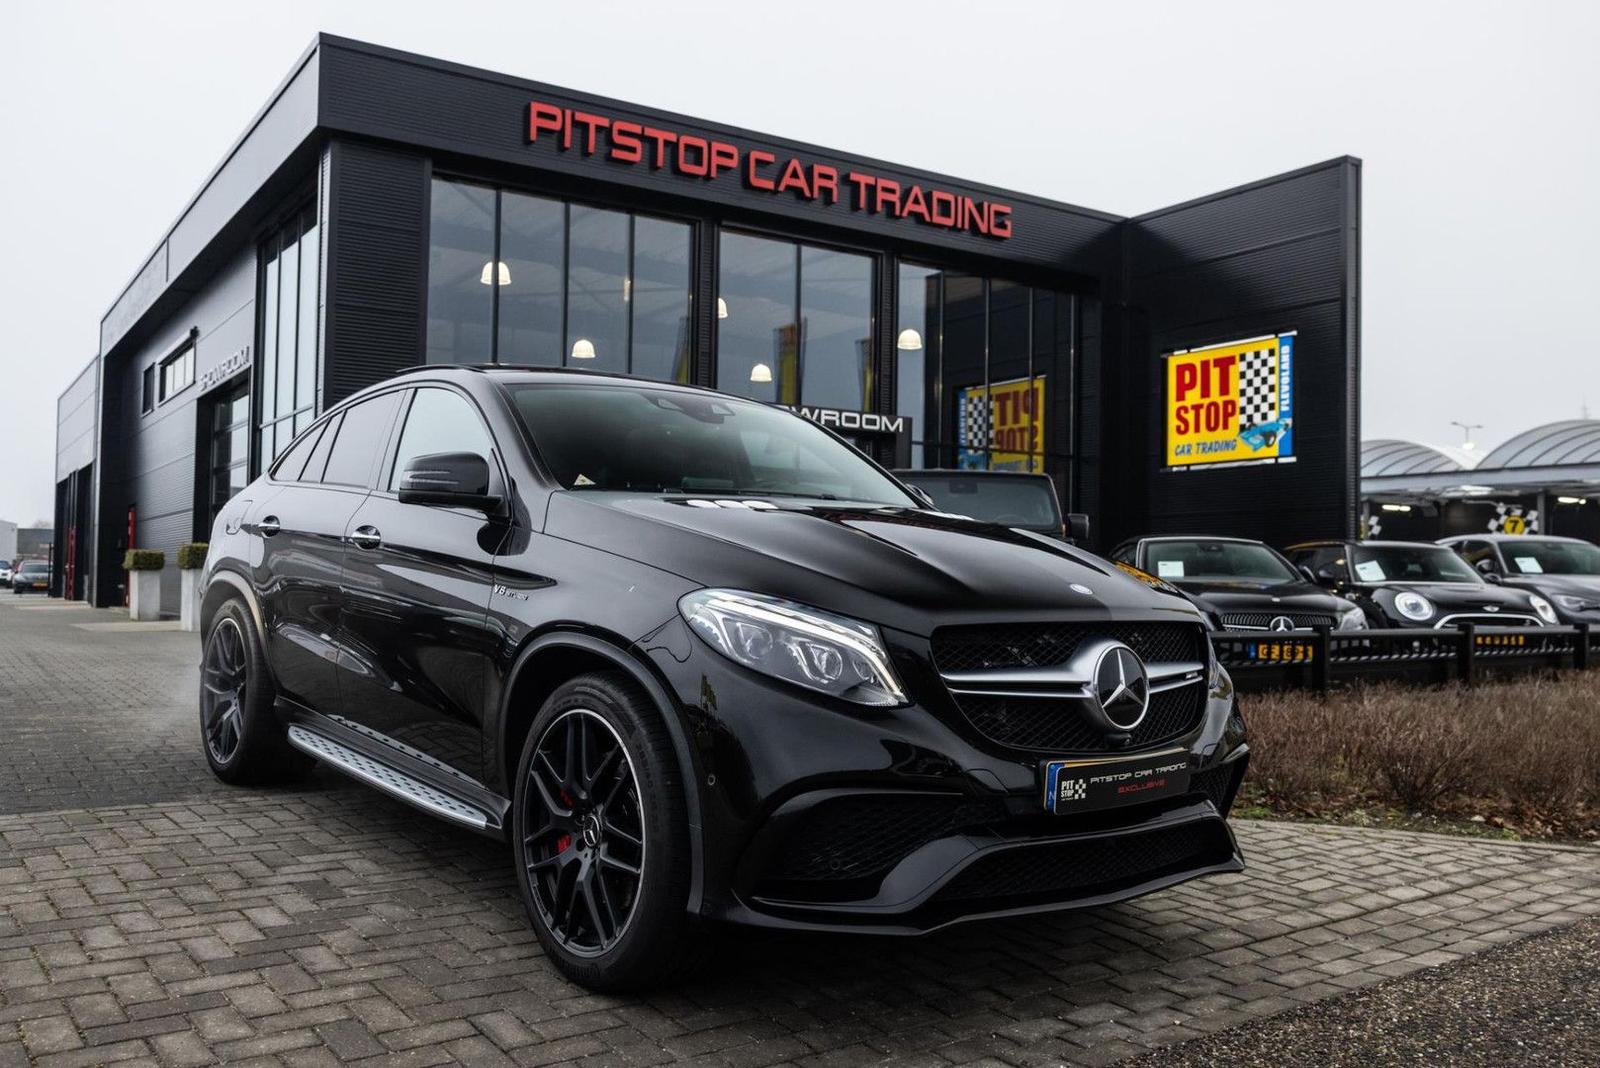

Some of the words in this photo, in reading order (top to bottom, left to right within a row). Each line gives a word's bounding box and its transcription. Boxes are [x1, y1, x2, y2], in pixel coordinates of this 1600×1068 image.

[529, 101, 739, 178] PITSTOP
[749, 150, 838, 203] CAR
[850, 172, 1012, 239] TRADING
[1175, 355, 1236, 402] PIT
[1175, 400, 1236, 435] STOP
[1175, 443, 1192, 456] CAR
[1196, 439, 1237, 453] TRADING
[1509, 519, 1520, 533] 7
[1090, 772, 1132, 784] PITSTOP
[1134, 769, 1153, 778] CAR
[1156, 762, 1186, 774] TRADING
[1061, 780, 1074, 790] PIT
[1061, 789, 1074, 798] STOP
[1118, 780, 1165, 793] EXCLUSIVE
